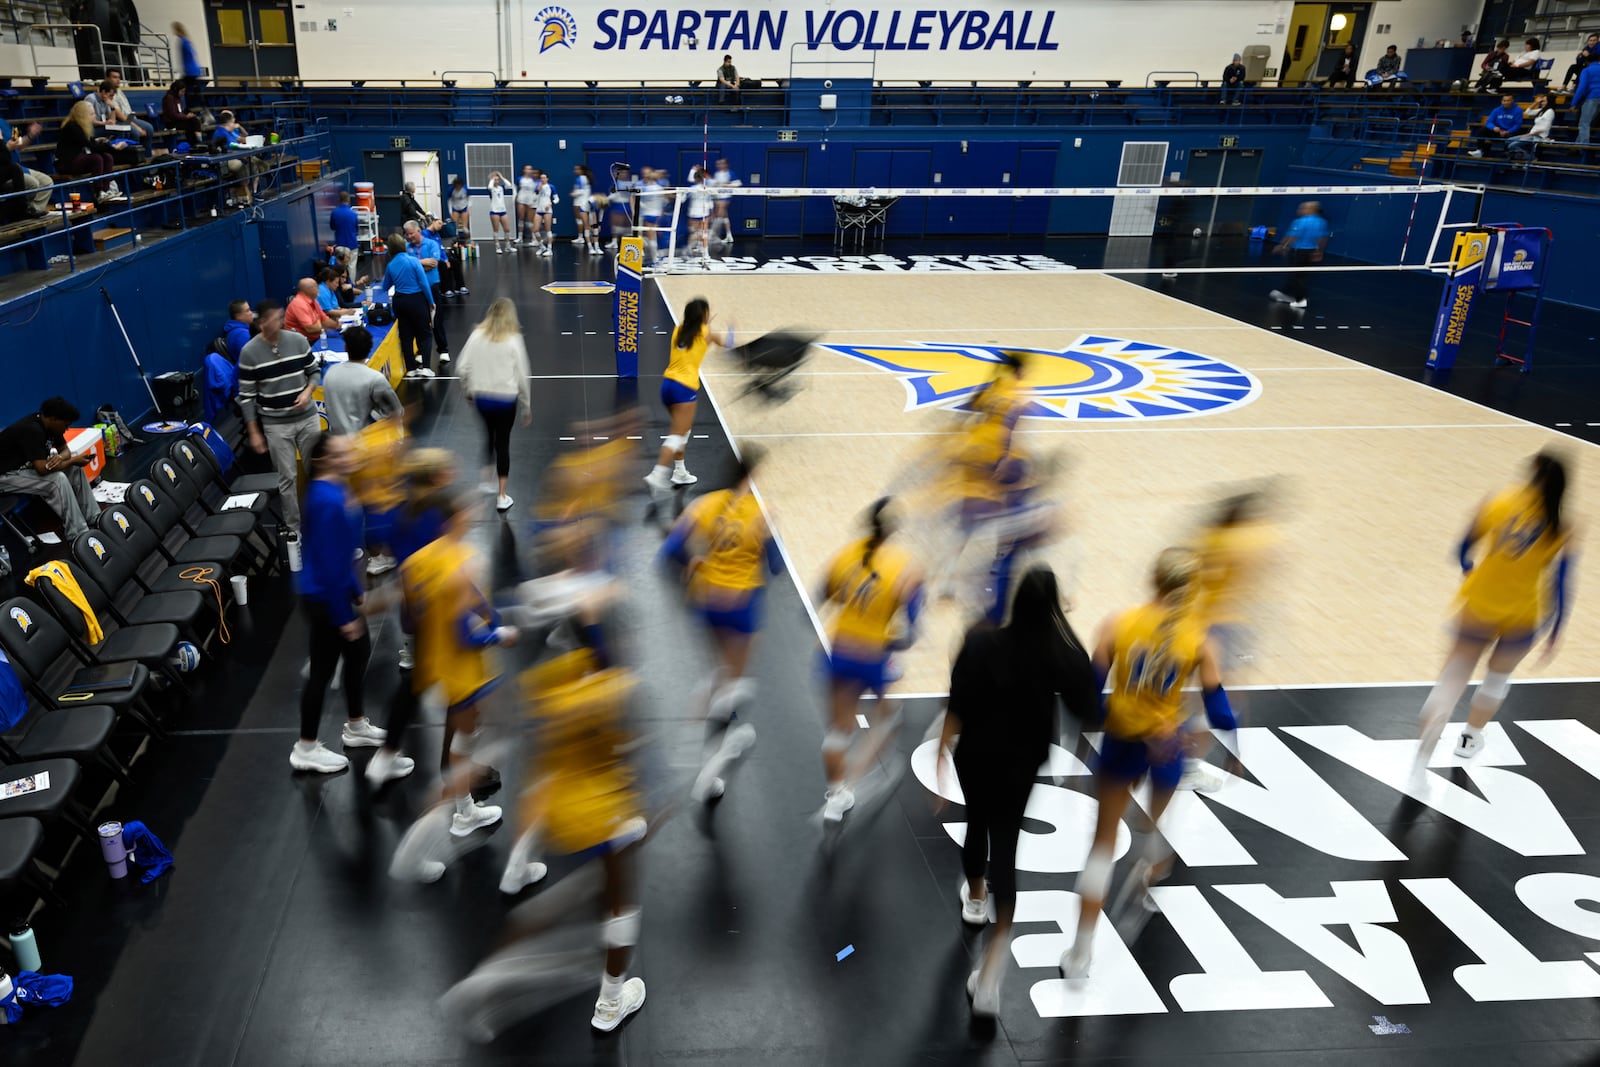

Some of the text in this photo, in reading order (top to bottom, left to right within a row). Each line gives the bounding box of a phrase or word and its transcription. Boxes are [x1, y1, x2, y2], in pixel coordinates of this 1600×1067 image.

[593, 9, 1059, 51] SPARTAN VOLLEYBALL
[394, 138, 406, 148] EXIT
[1223, 137, 1235, 146] EXIT
[746, 219, 757, 228] EXIT
[619, 290, 628, 314] STATE
[1465, 285, 1475, 301] SAN
[625, 292, 639, 353] SPARTANS
[1444, 284, 1467, 345] SPARTANS
[1454, 322, 1465, 345] STATE
[618, 335, 626, 353] SAN
